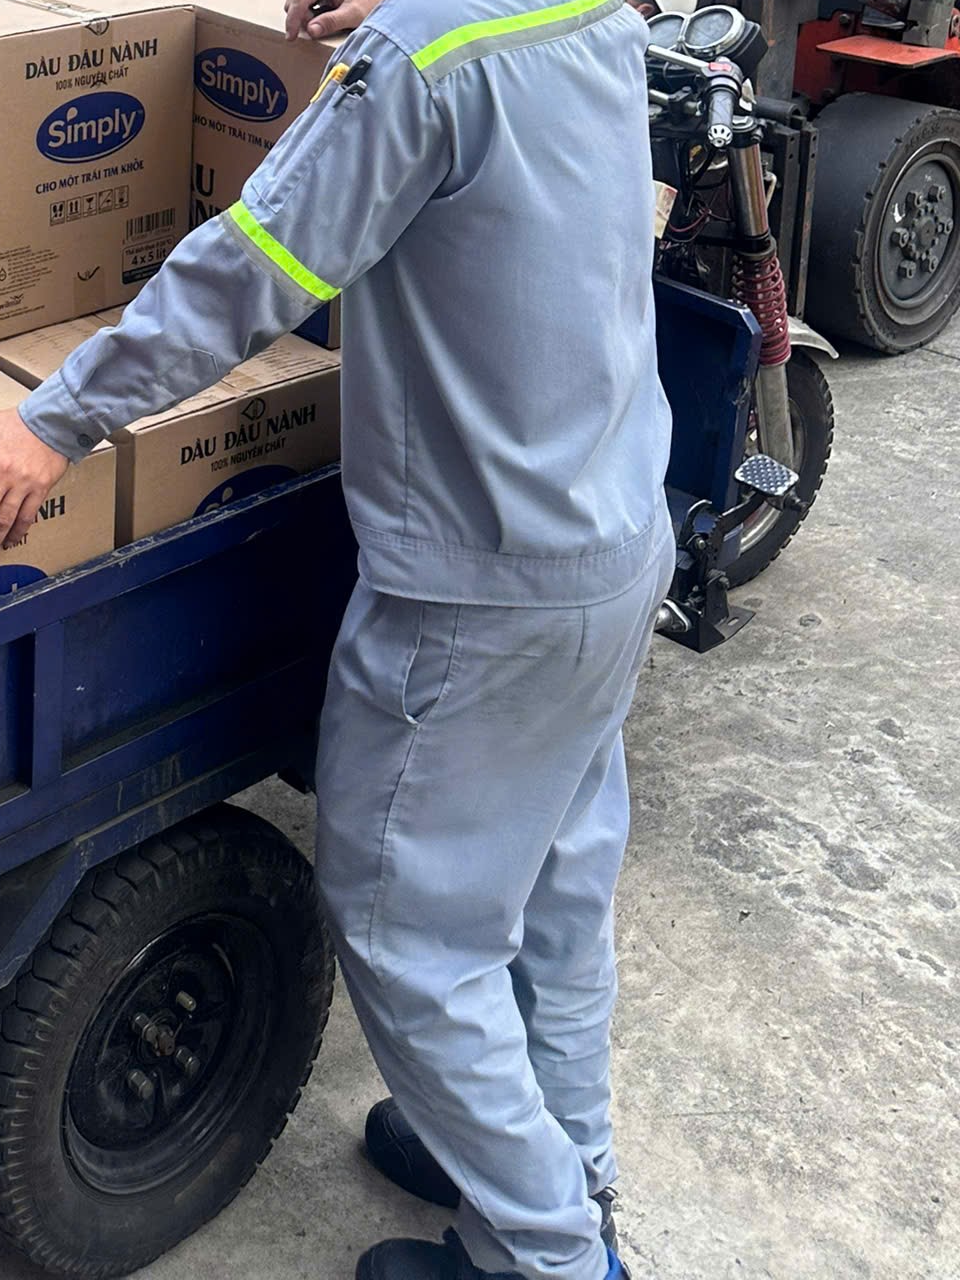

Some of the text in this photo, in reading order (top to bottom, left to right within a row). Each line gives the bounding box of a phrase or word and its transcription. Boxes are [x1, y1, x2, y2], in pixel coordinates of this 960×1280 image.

[109, 38, 158, 64] NÀNH
[201, 54, 280, 114] Simply
[48, 107, 136, 148] Simply
[247, 132, 263, 146] TIM
[35, 180, 57, 195] CHO
[103, 166, 118, 178] TIM
[131, 255, 138, 265] 4
[148, 251, 154, 262] 5
[266, 403, 316, 435] NÀNH
